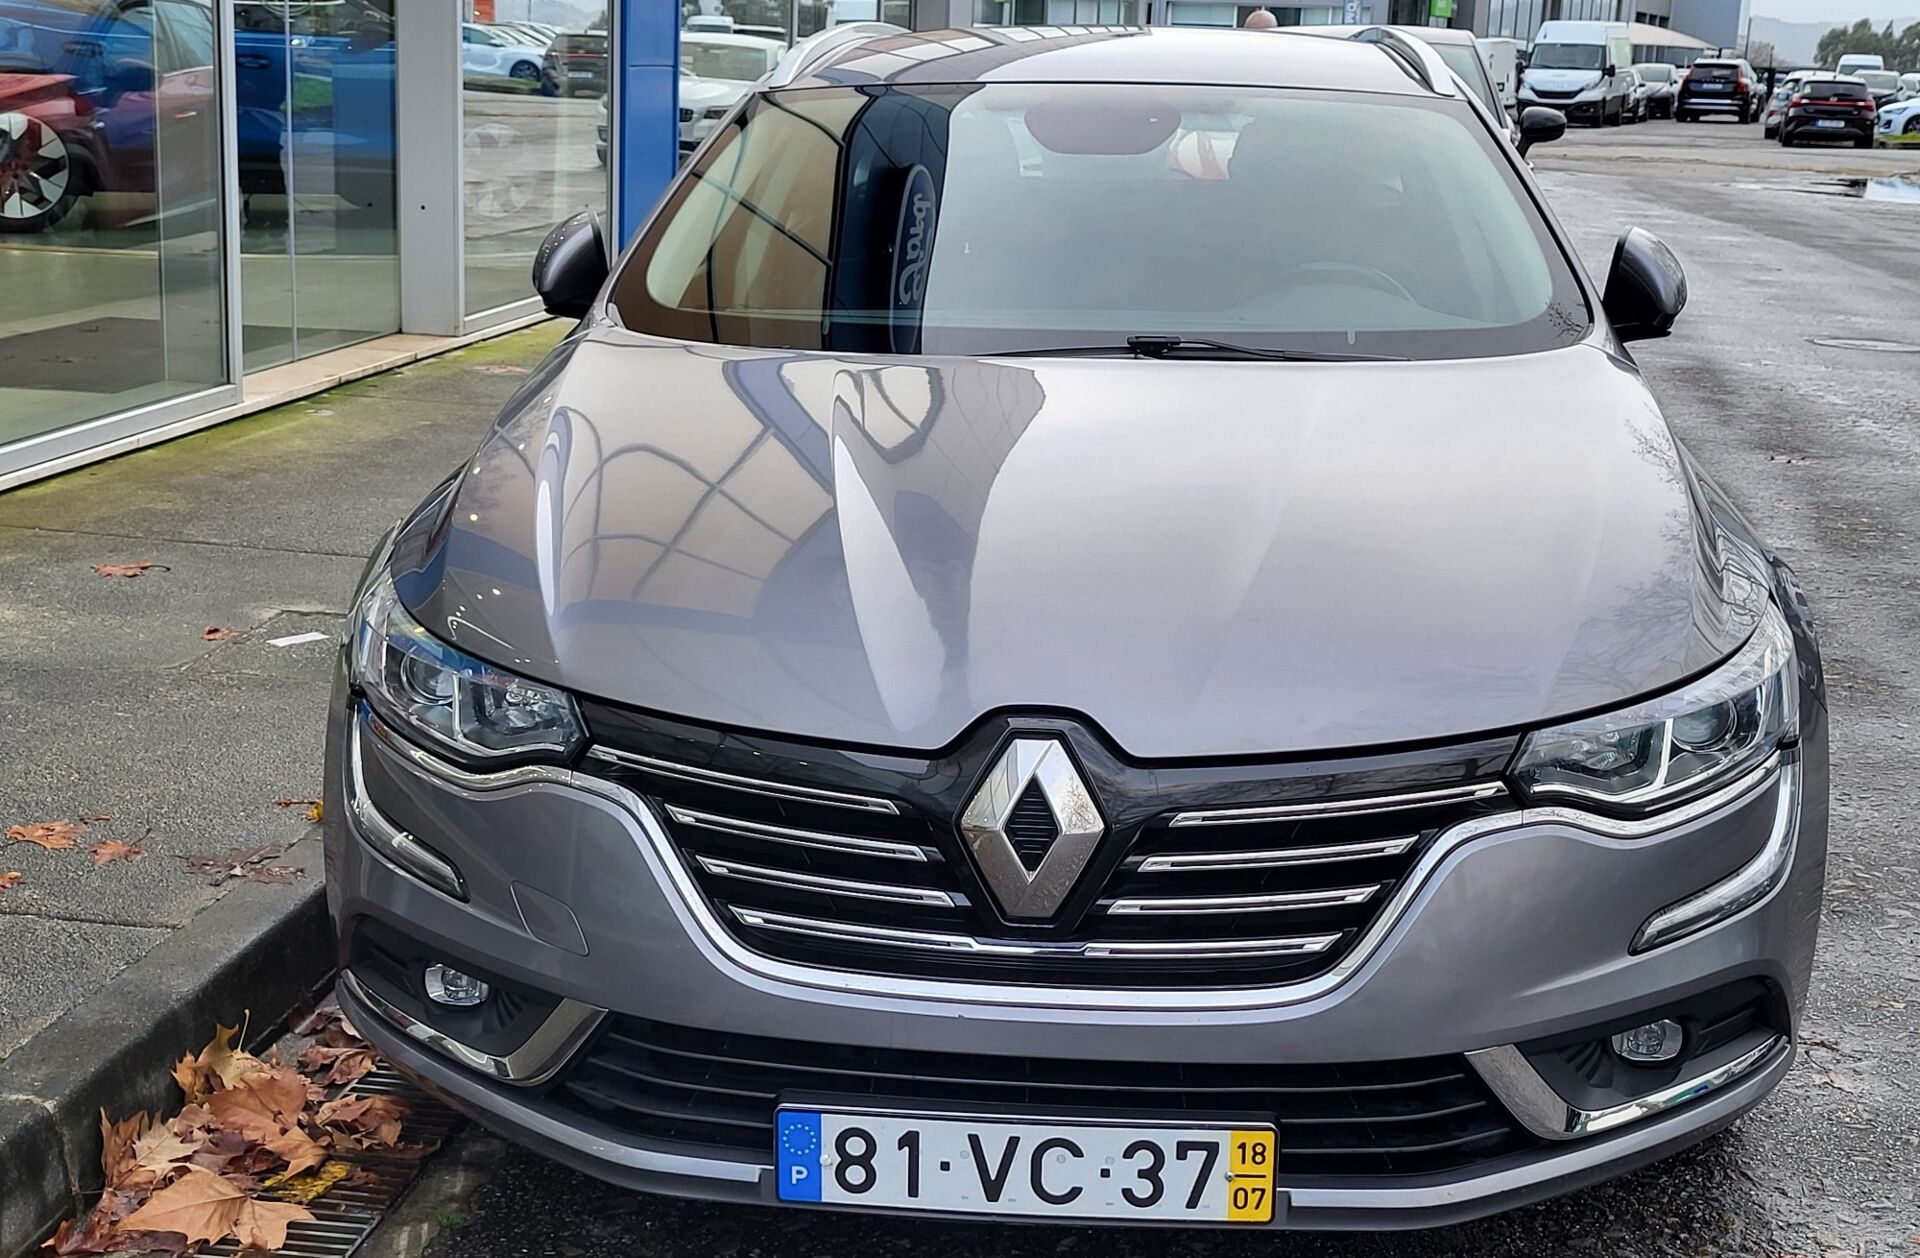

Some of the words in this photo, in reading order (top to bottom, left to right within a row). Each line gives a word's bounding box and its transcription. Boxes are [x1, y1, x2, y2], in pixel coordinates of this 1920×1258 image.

[1236, 1141, 1267, 1166] 18
[791, 1166, 809, 1185] P
[1232, 1186, 1267, 1211] 07
